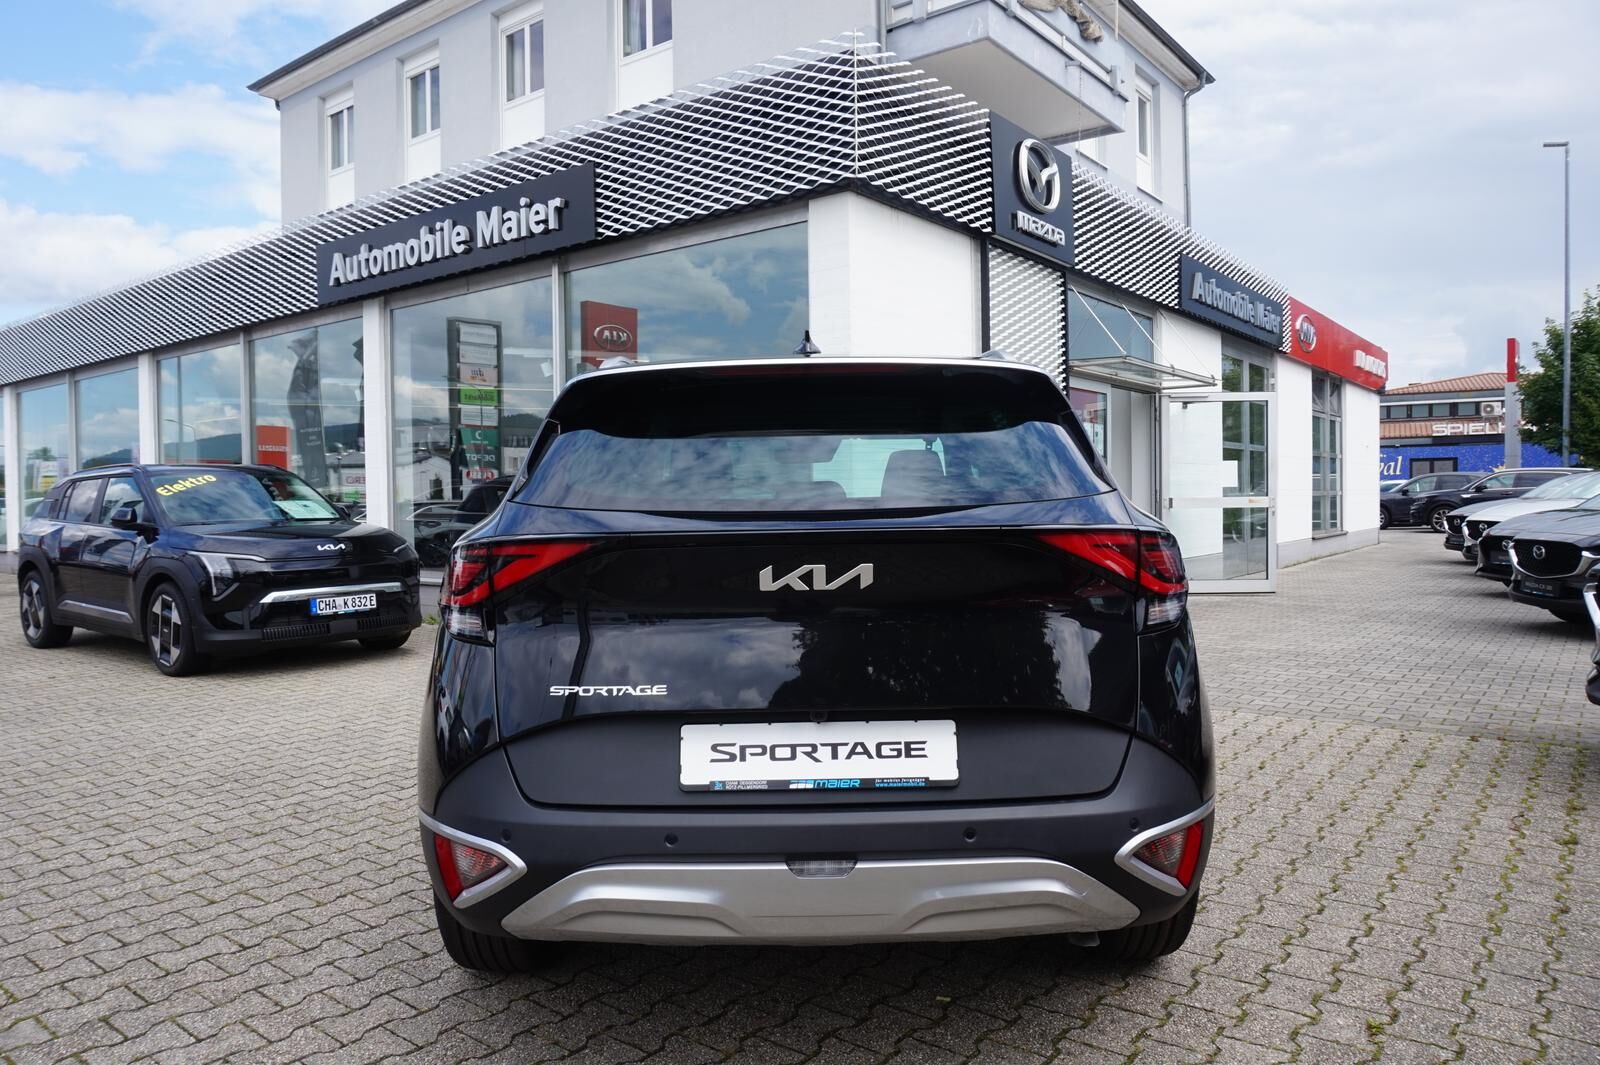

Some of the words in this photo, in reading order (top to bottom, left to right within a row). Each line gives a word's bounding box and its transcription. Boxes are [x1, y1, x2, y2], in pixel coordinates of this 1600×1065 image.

[329, 219, 471, 286] Automobile
[476, 197, 565, 248] Maier
[1192, 272, 1255, 323] Automobile
[1254, 301, 1280, 333] Maier
[155, 474, 217, 497] Elektro
[759, 563, 874, 591] KIA
[318, 599, 337, 612] CHA
[549, 684, 668, 697] SPORTAGE
[709, 740, 929, 763] SPORTAGE
